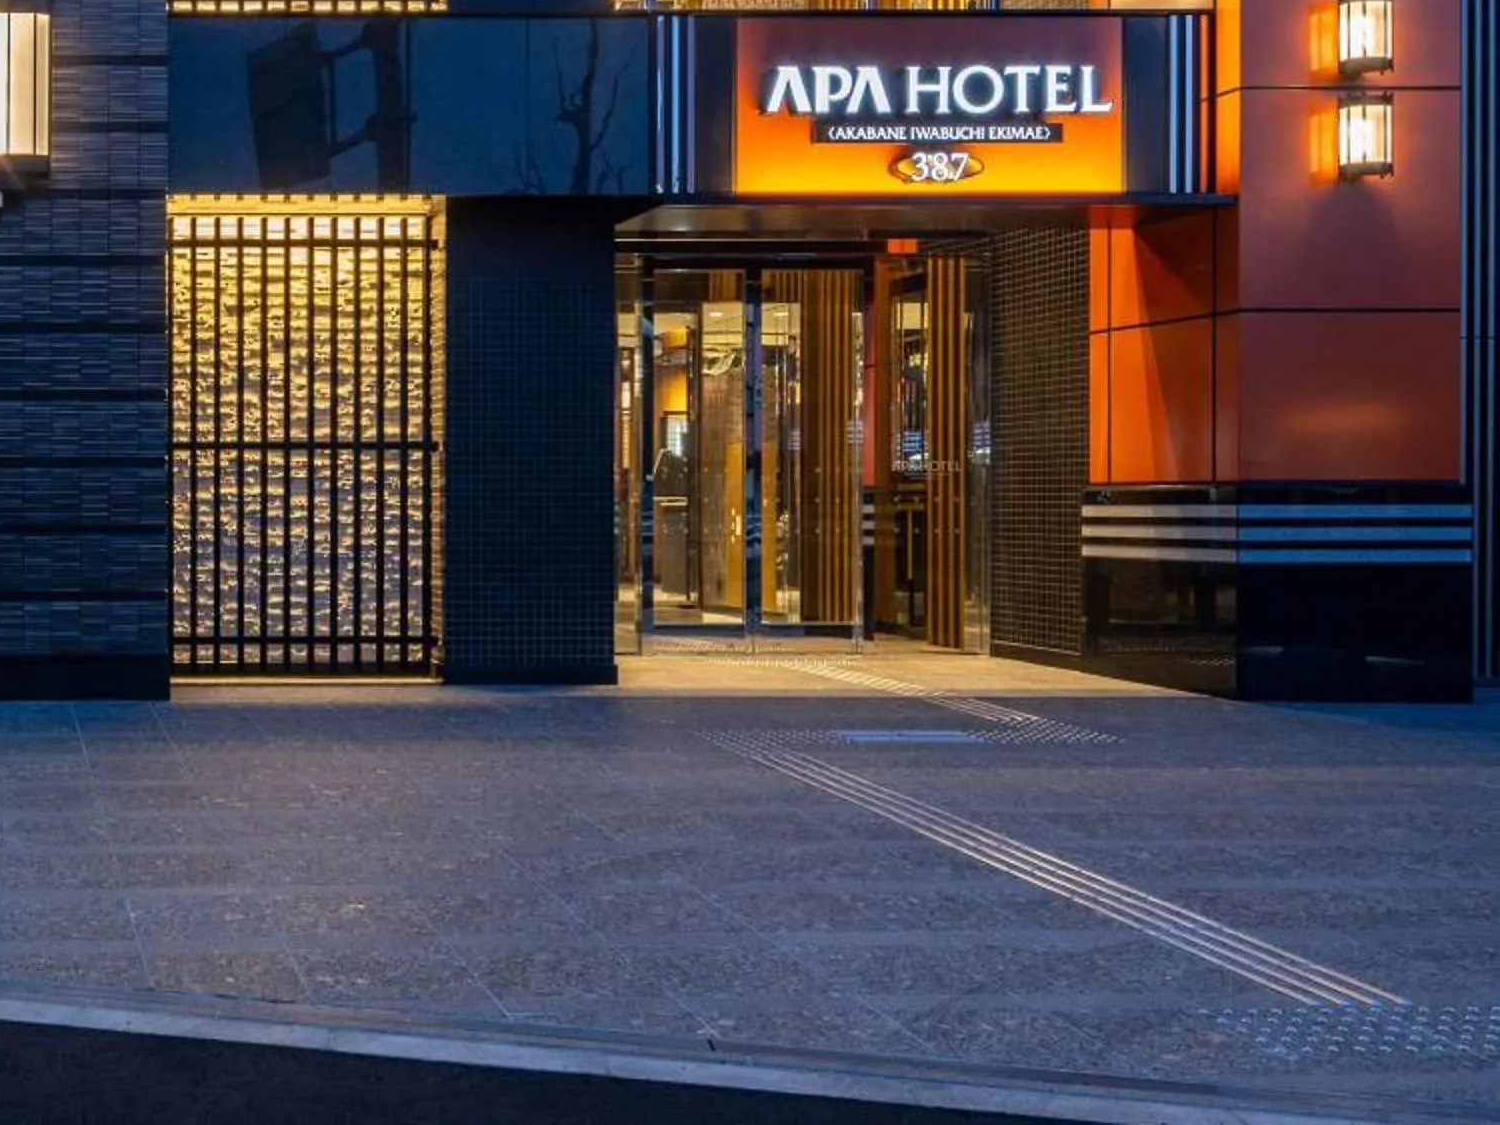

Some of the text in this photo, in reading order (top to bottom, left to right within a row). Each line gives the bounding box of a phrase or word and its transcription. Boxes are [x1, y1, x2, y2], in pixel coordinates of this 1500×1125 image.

[766, 64, 1113, 115] APA HOTEL
[910, 126, 986, 140] IWABUCHI
[911, 151, 969, 182] 387
